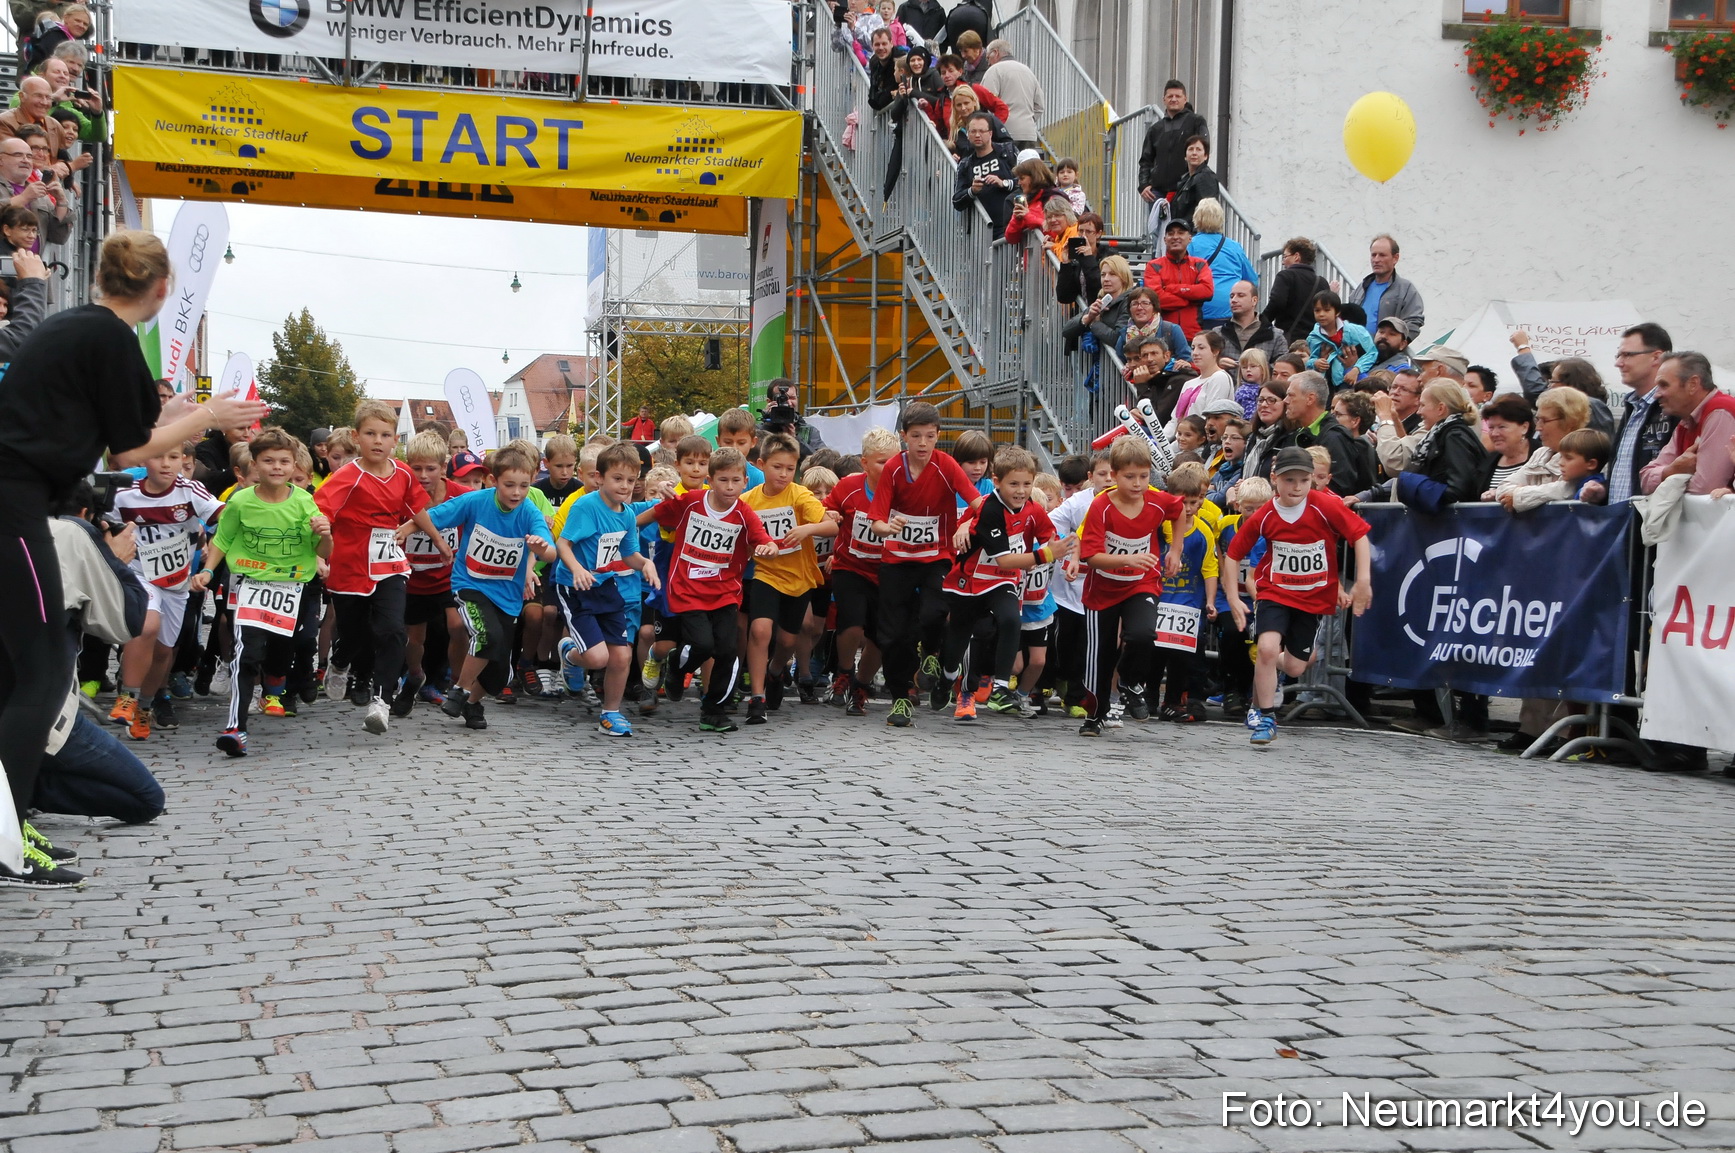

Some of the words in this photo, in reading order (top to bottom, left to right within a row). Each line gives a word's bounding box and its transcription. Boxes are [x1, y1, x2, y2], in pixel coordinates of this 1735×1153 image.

[326, 0, 404, 18] BMW
[414, 0, 673, 37] EfficientDynamics
[326, 21, 406, 44] Weniger
[411, 27, 512, 50] Verbrauch.
[517, 35, 565, 52] Mehr
[570, 38, 673, 59] Fhrfreude.
[154, 119, 239, 136] Neumarkter
[243, 127, 309, 143] Stadtlauf
[350, 106, 583, 170] START
[624, 152, 701, 166] Neumarkter
[704, 155, 764, 169] Stadtlauf
[973, 159, 999, 179] 952
[589, 190, 662, 205] Neumarkter
[663, 194, 719, 208] Stadtlauf
[174, 287, 195, 334] BKK
[1537, 325, 1572, 335] UNS
[1149, 420, 1167, 443] BMW
[690, 515, 706, 527] PARTL
[707, 522, 733, 533] Neumarkt
[761, 511, 786, 519] Neumarkt
[473, 529, 489, 542] PARTL
[490, 537, 516, 548] Neumarkt
[691, 525, 734, 551] 7034
[140, 548, 160, 557] PARTL
[472, 538, 519, 567] 7036
[1273, 544, 1290, 553] PARTL
[147, 543, 189, 577] 7051
[236, 559, 267, 570] MERZ
[1277, 553, 1323, 573] 7008
[265, 580, 293, 590] Neumarkt
[247, 587, 296, 614] 7005
[1171, 608, 1194, 616] Neumarkt
[1427, 585, 1563, 638] Fischer
[1157, 613, 1196, 635] 7132
